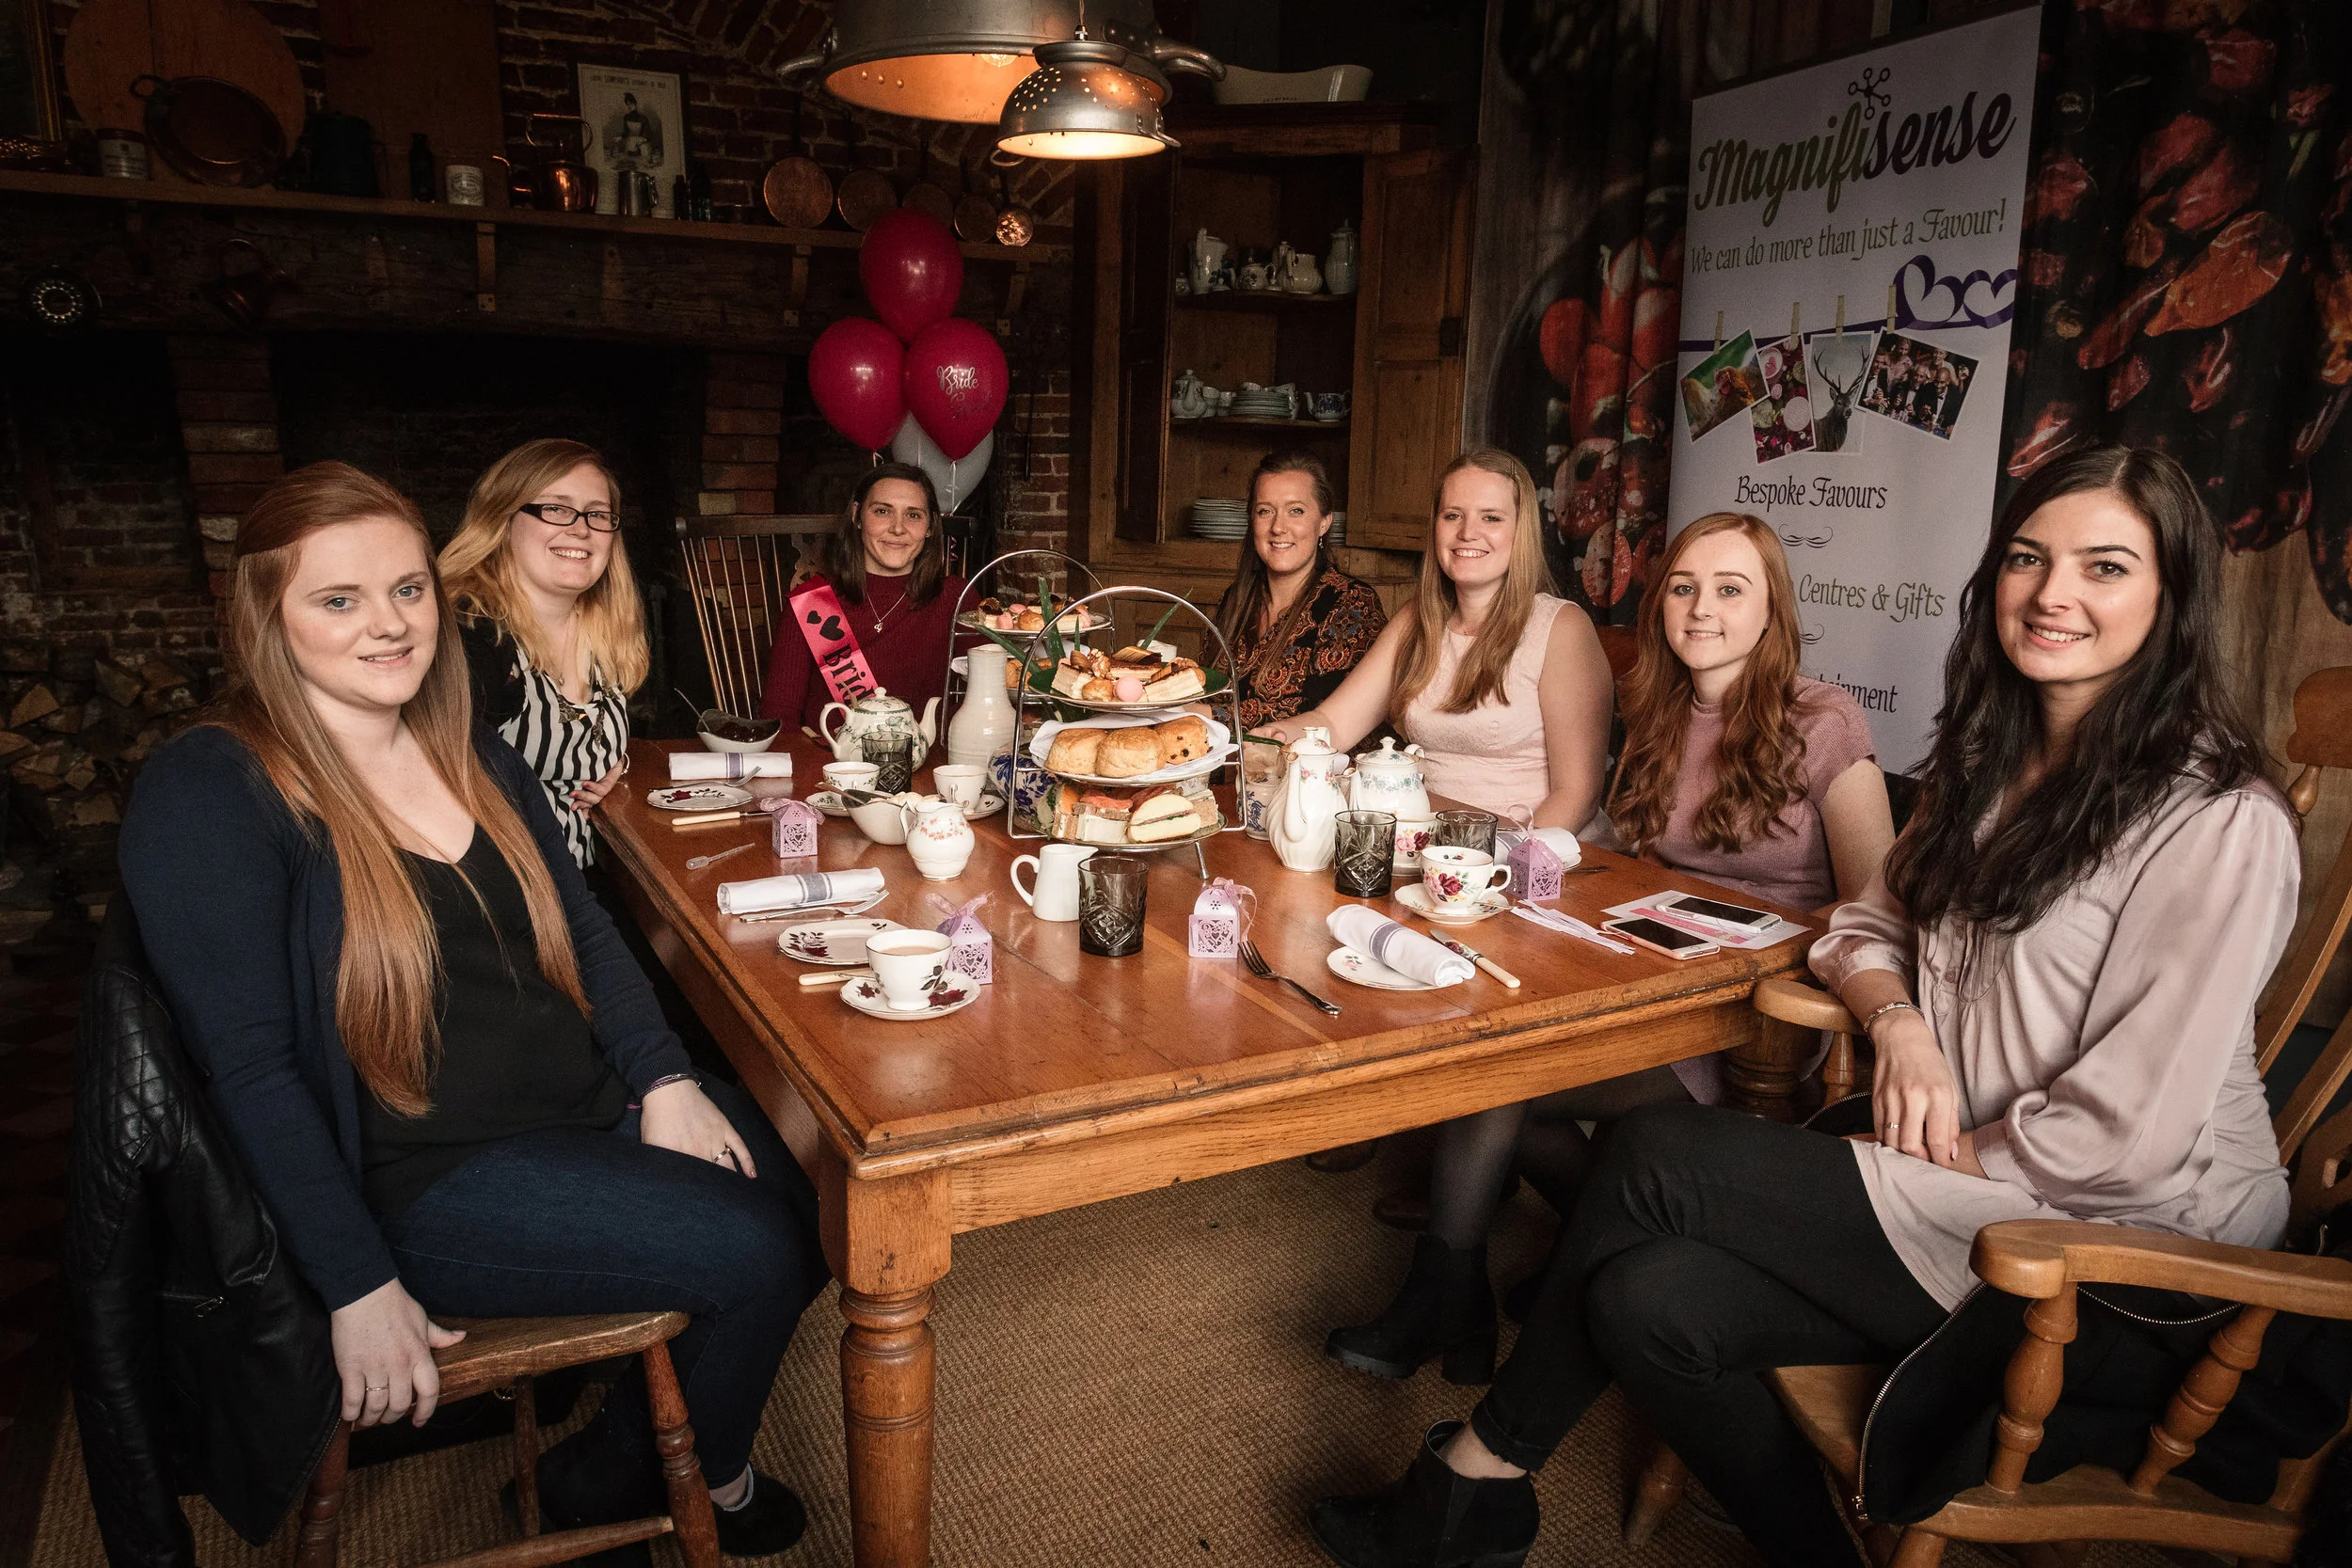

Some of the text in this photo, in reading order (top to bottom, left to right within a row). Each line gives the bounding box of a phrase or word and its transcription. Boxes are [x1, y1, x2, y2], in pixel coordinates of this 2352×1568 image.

[1694, 91, 2016, 228] Magnifisense
[1692, 198, 2007, 275] We can do more than just a Favour!
[936, 365, 979, 395] Bride
[1734, 475, 1888, 513] Bespoke Favours
[1799, 574, 1947, 623] Centres & Gifts
[822, 642, 878, 711] Brid
